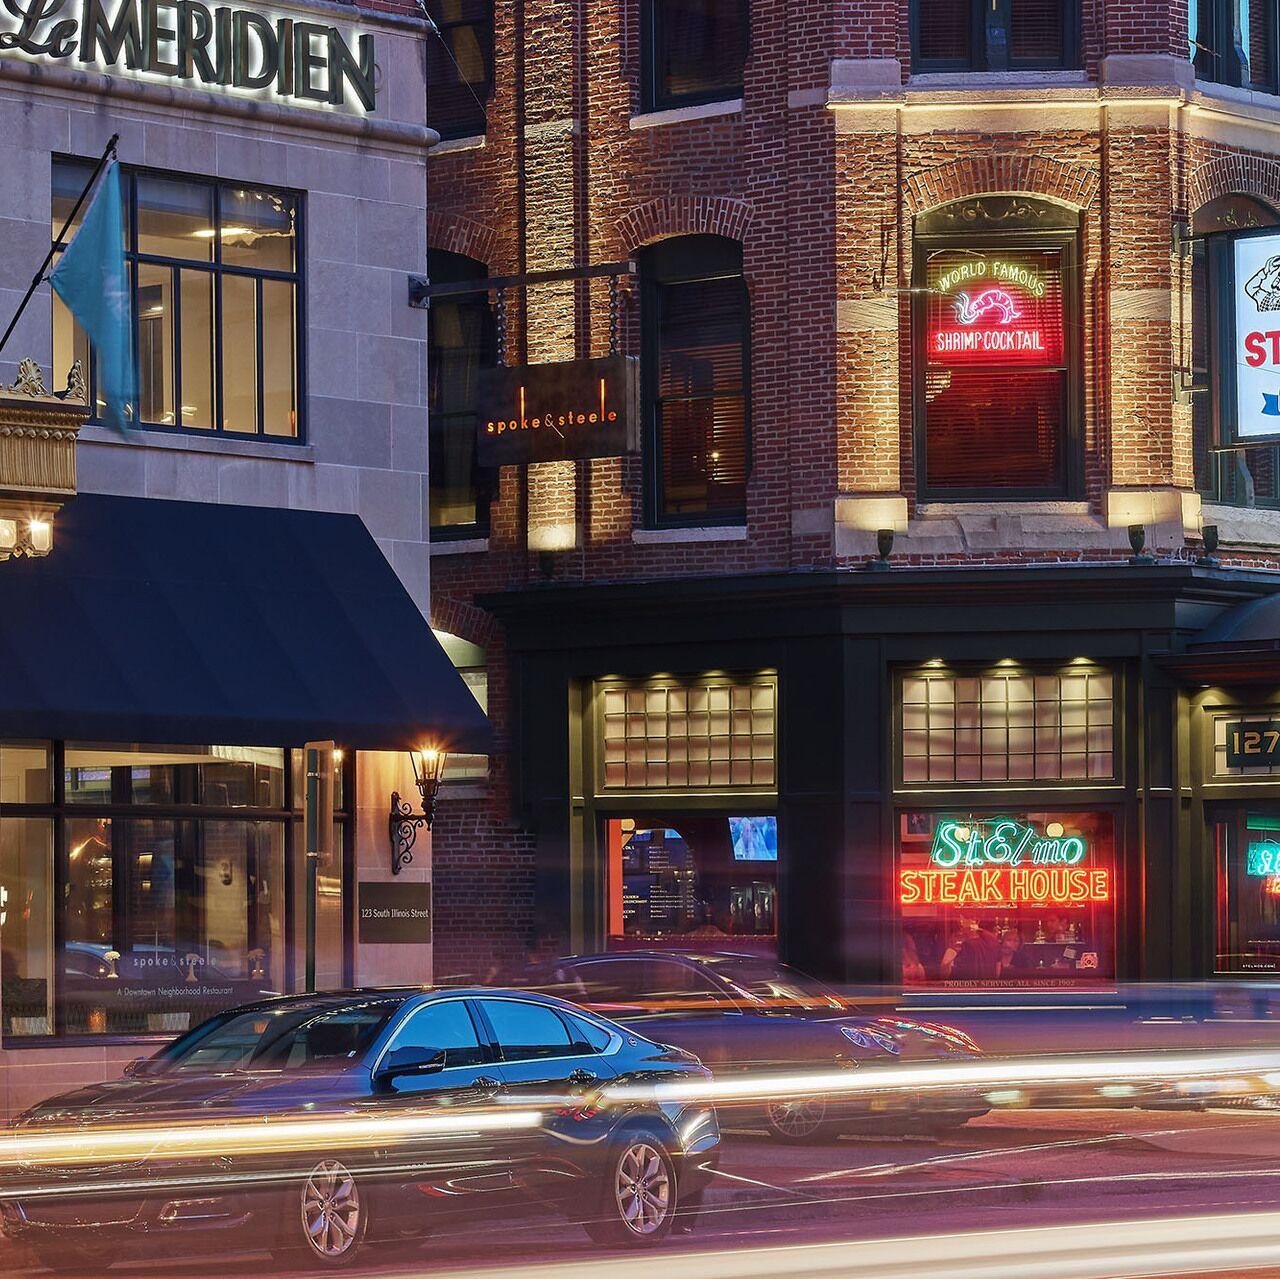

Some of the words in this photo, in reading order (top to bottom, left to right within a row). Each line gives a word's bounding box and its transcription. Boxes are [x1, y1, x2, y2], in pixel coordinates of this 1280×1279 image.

[938, 261, 987, 292] WORLD
[993, 261, 1045, 296] FAMOUS
[937, 331, 982, 351] SHRIMP
[983, 331, 1045, 350] COCKTAIL
[984, 822, 1084, 867] Elmo
[900, 869, 1003, 903] STEAK
[1010, 869, 1109, 902] HOUSE
[361, 908, 372, 918] 123
[372, 908, 390, 918] South
[391, 908, 410, 918] Illinois
[410, 908, 429, 918] Street
[124, 987, 156, 996] Downtown
[158, 986, 201, 997] Neighborhood
[202, 986, 233, 994] Restaurant
